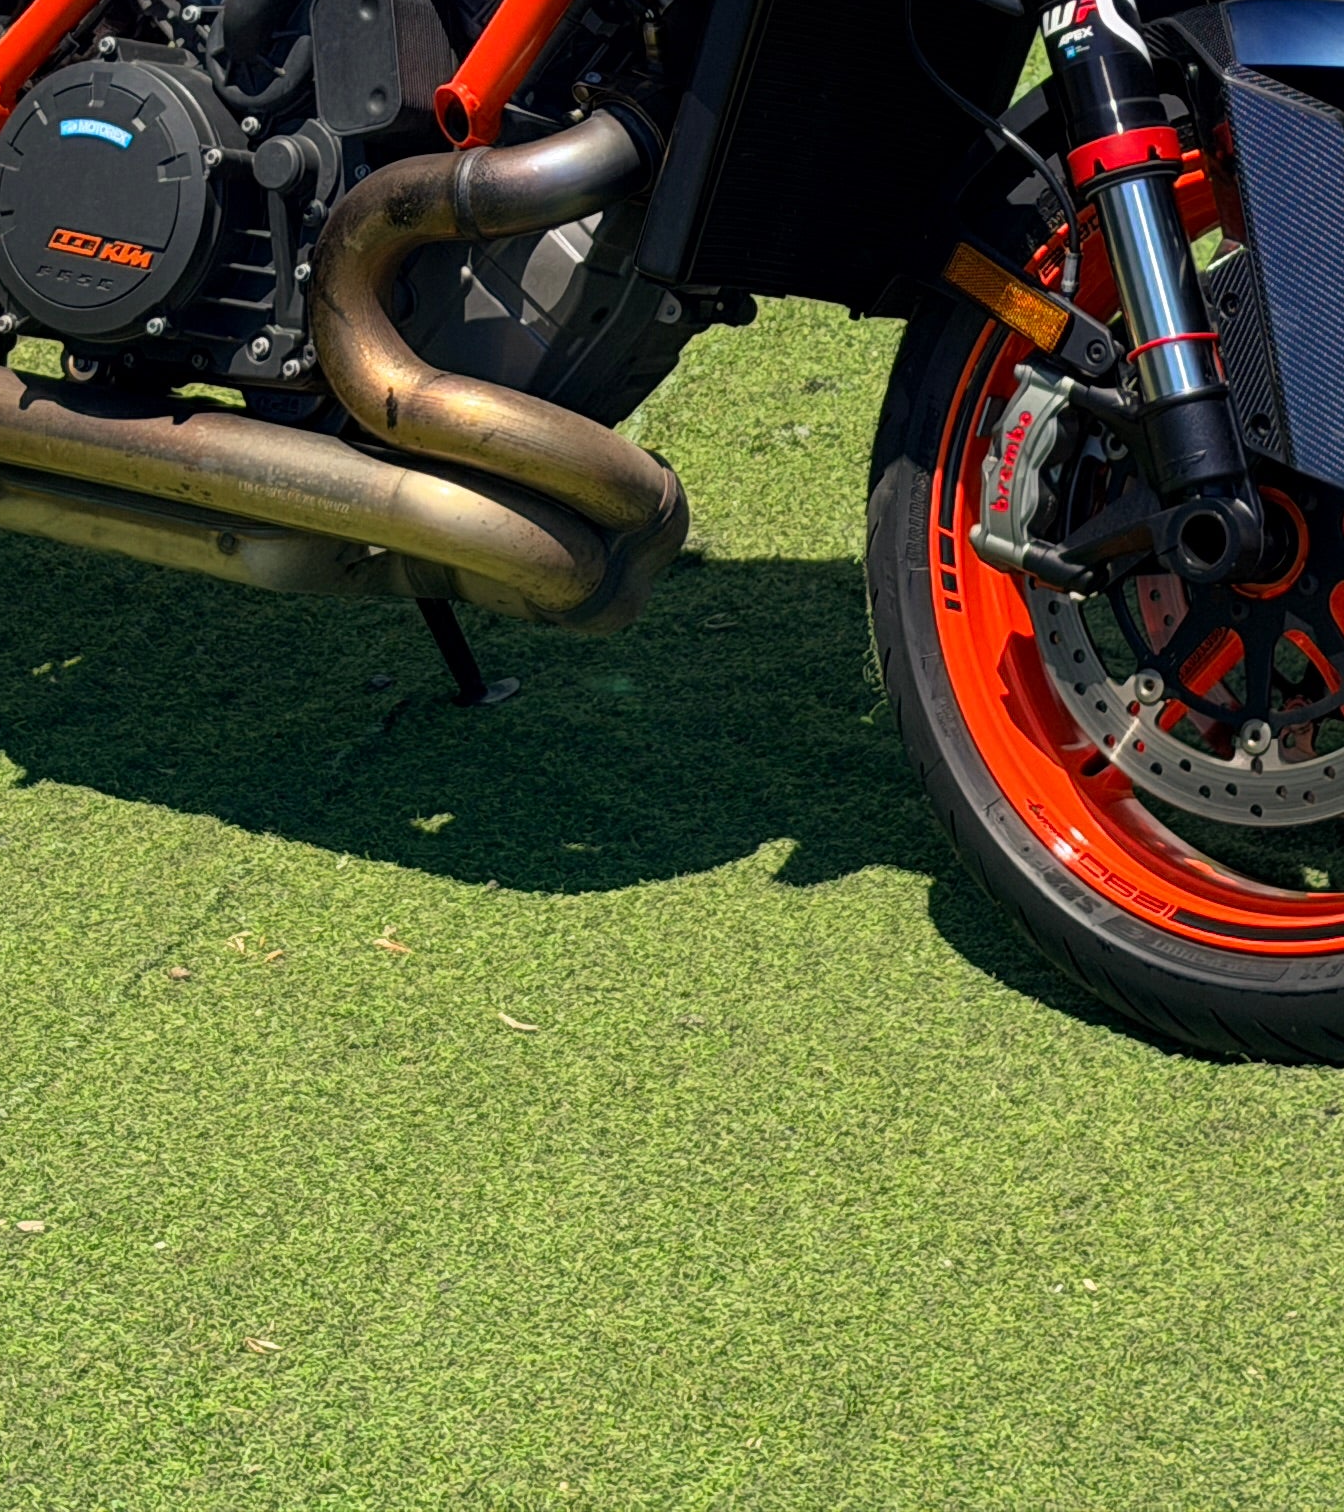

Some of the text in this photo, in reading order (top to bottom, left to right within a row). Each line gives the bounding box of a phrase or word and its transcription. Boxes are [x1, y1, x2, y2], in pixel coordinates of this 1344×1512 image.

[1058, 26, 1094, 48] APEX
[99, 240, 154, 270] KTM
[990, 410, 1033, 513] brembo
[1077, 851, 1175, 918] 1290
